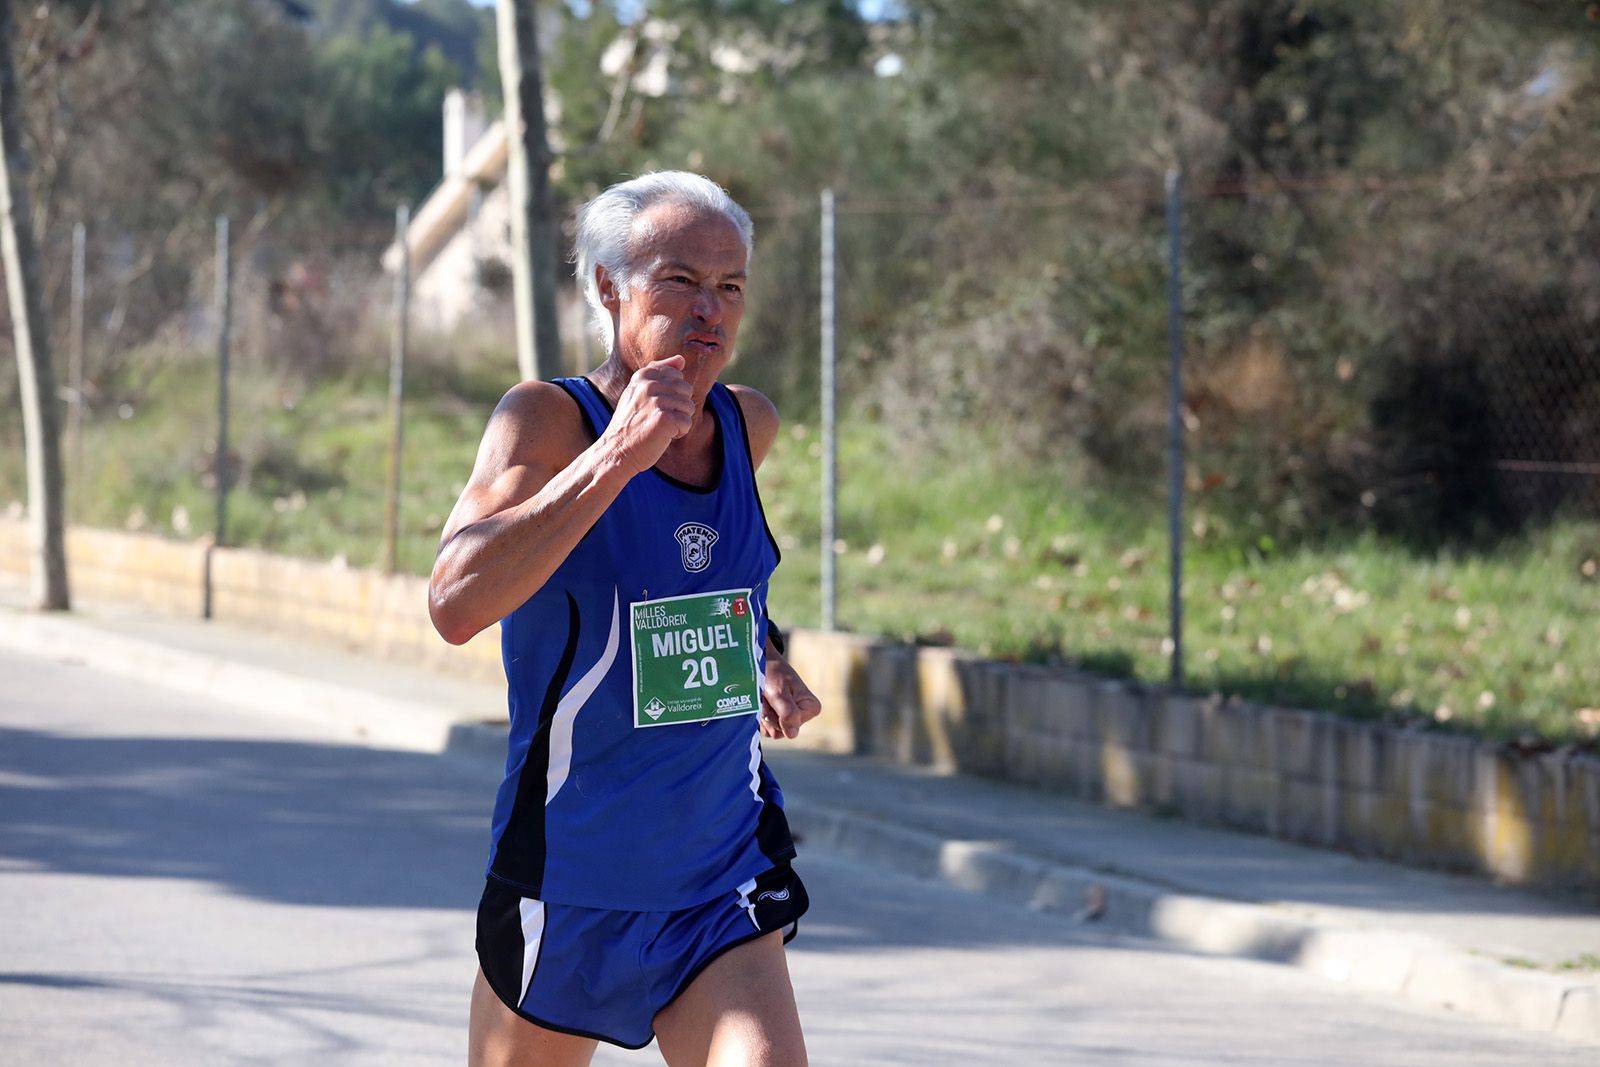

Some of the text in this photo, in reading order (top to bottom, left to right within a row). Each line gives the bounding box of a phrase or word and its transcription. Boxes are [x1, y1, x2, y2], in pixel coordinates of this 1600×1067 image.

[635, 605, 666, 620] MILLES
[635, 613, 688, 631] VALLDOREIX
[651, 623, 739, 658] MIGUEL
[681, 656, 719, 690] 20
[667, 703, 703, 713] Valldoreix
[716, 694, 751, 708] COMPLEX
